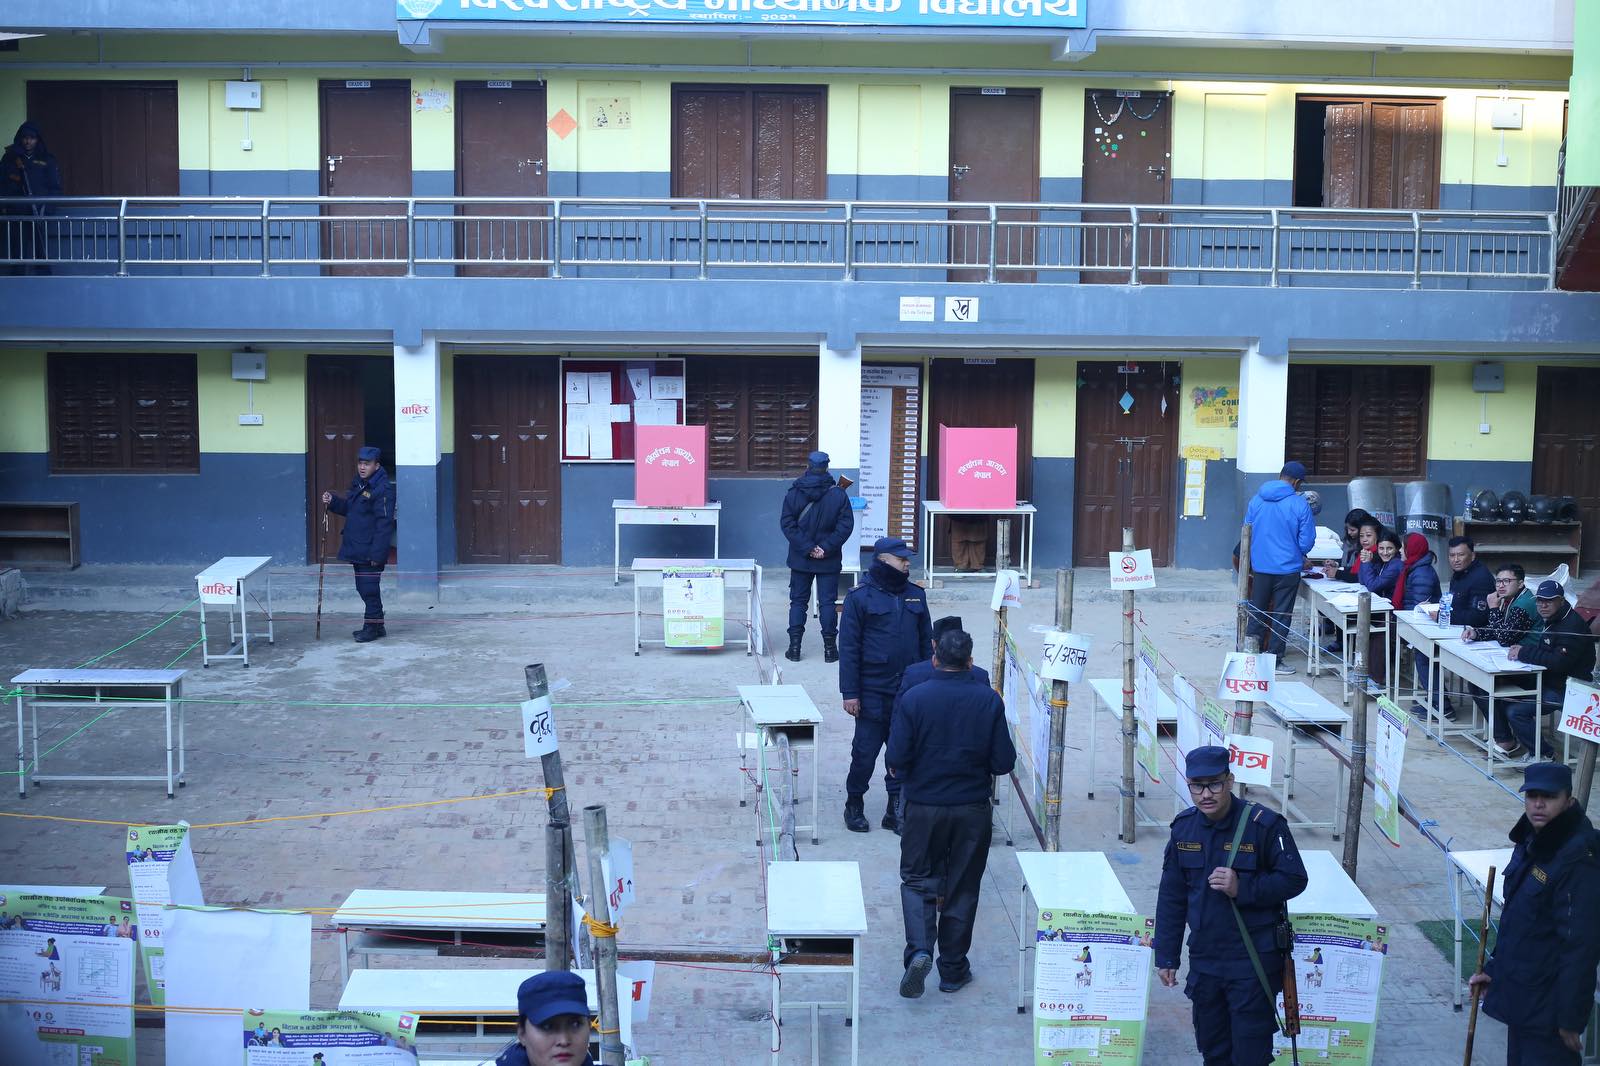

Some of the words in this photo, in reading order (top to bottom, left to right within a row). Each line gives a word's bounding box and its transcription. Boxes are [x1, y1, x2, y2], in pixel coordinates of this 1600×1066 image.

[1406, 520, 1422, 529] NEPAL
[1422, 520, 1438, 530] POLICE
[202, 582, 234, 596] बाहिर
